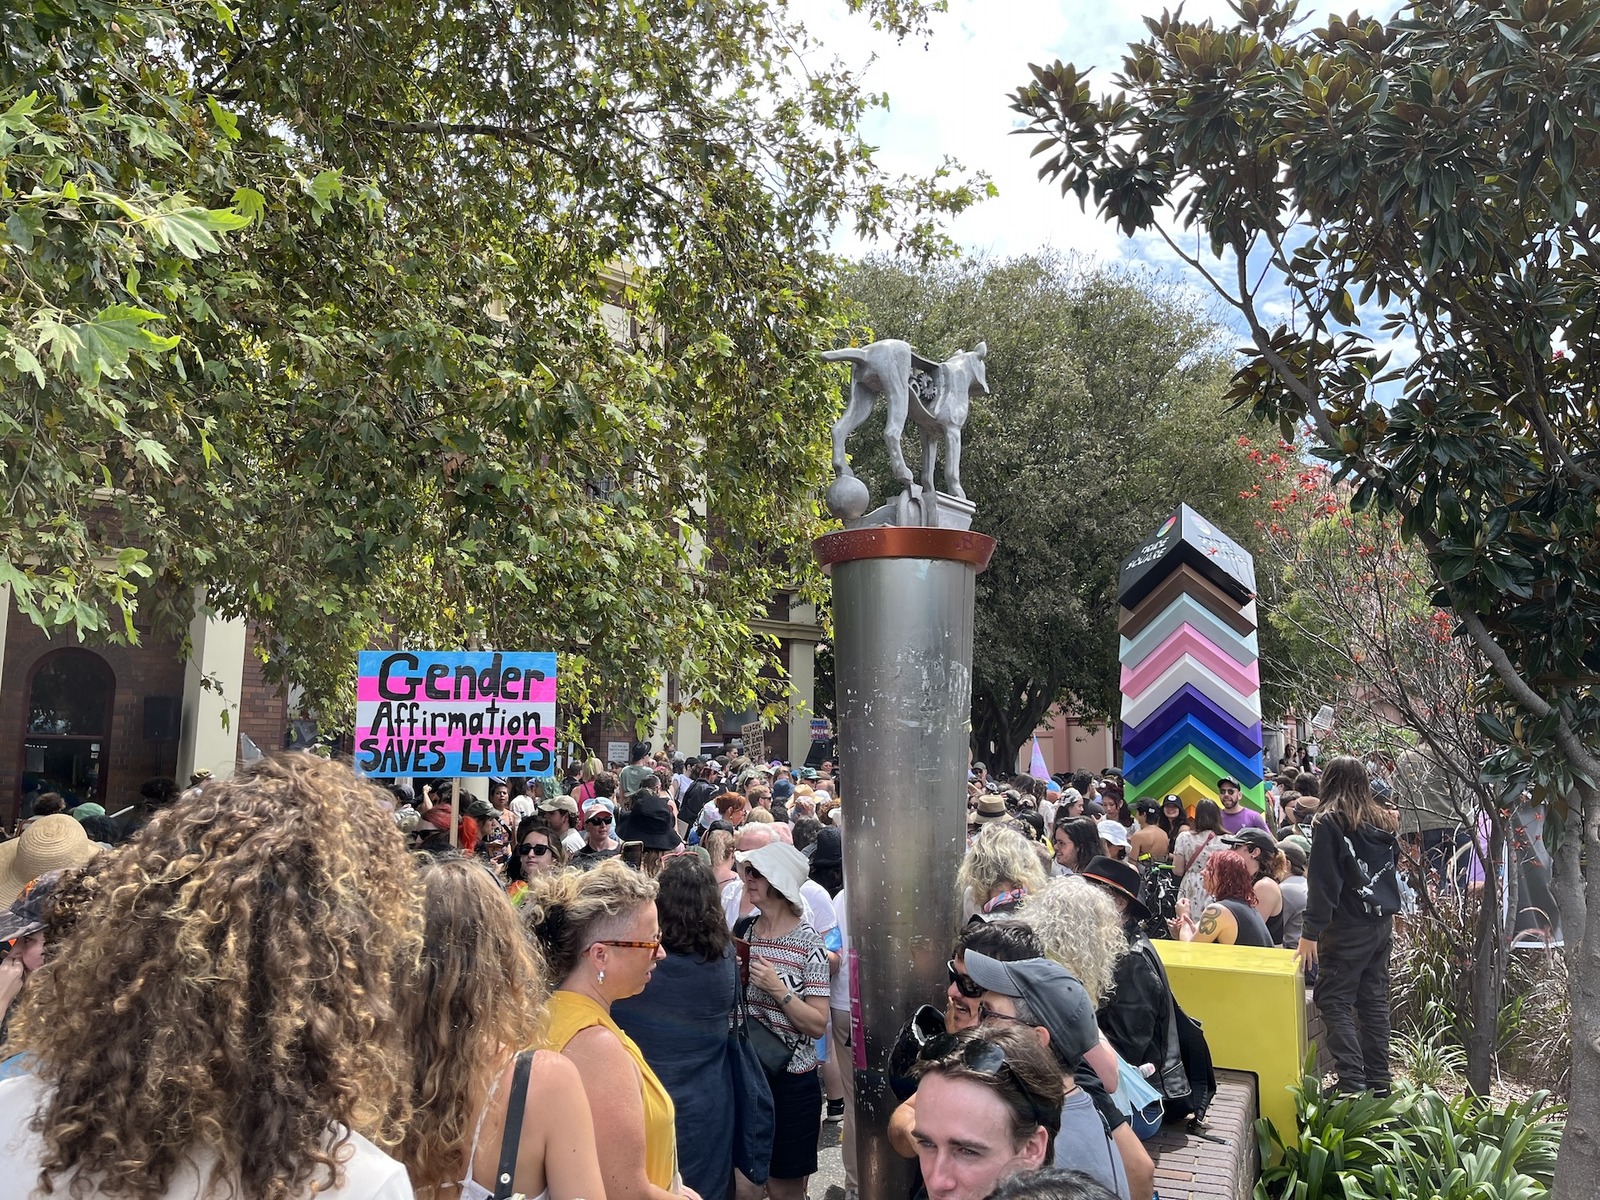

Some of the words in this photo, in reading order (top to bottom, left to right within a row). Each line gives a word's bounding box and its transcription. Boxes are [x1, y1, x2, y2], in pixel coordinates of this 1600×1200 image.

[378, 652, 545, 701] Gender
[370, 698, 541, 737] Affirmation
[359, 738, 446, 773] SAVES
[461, 737, 550, 773] LIVES
